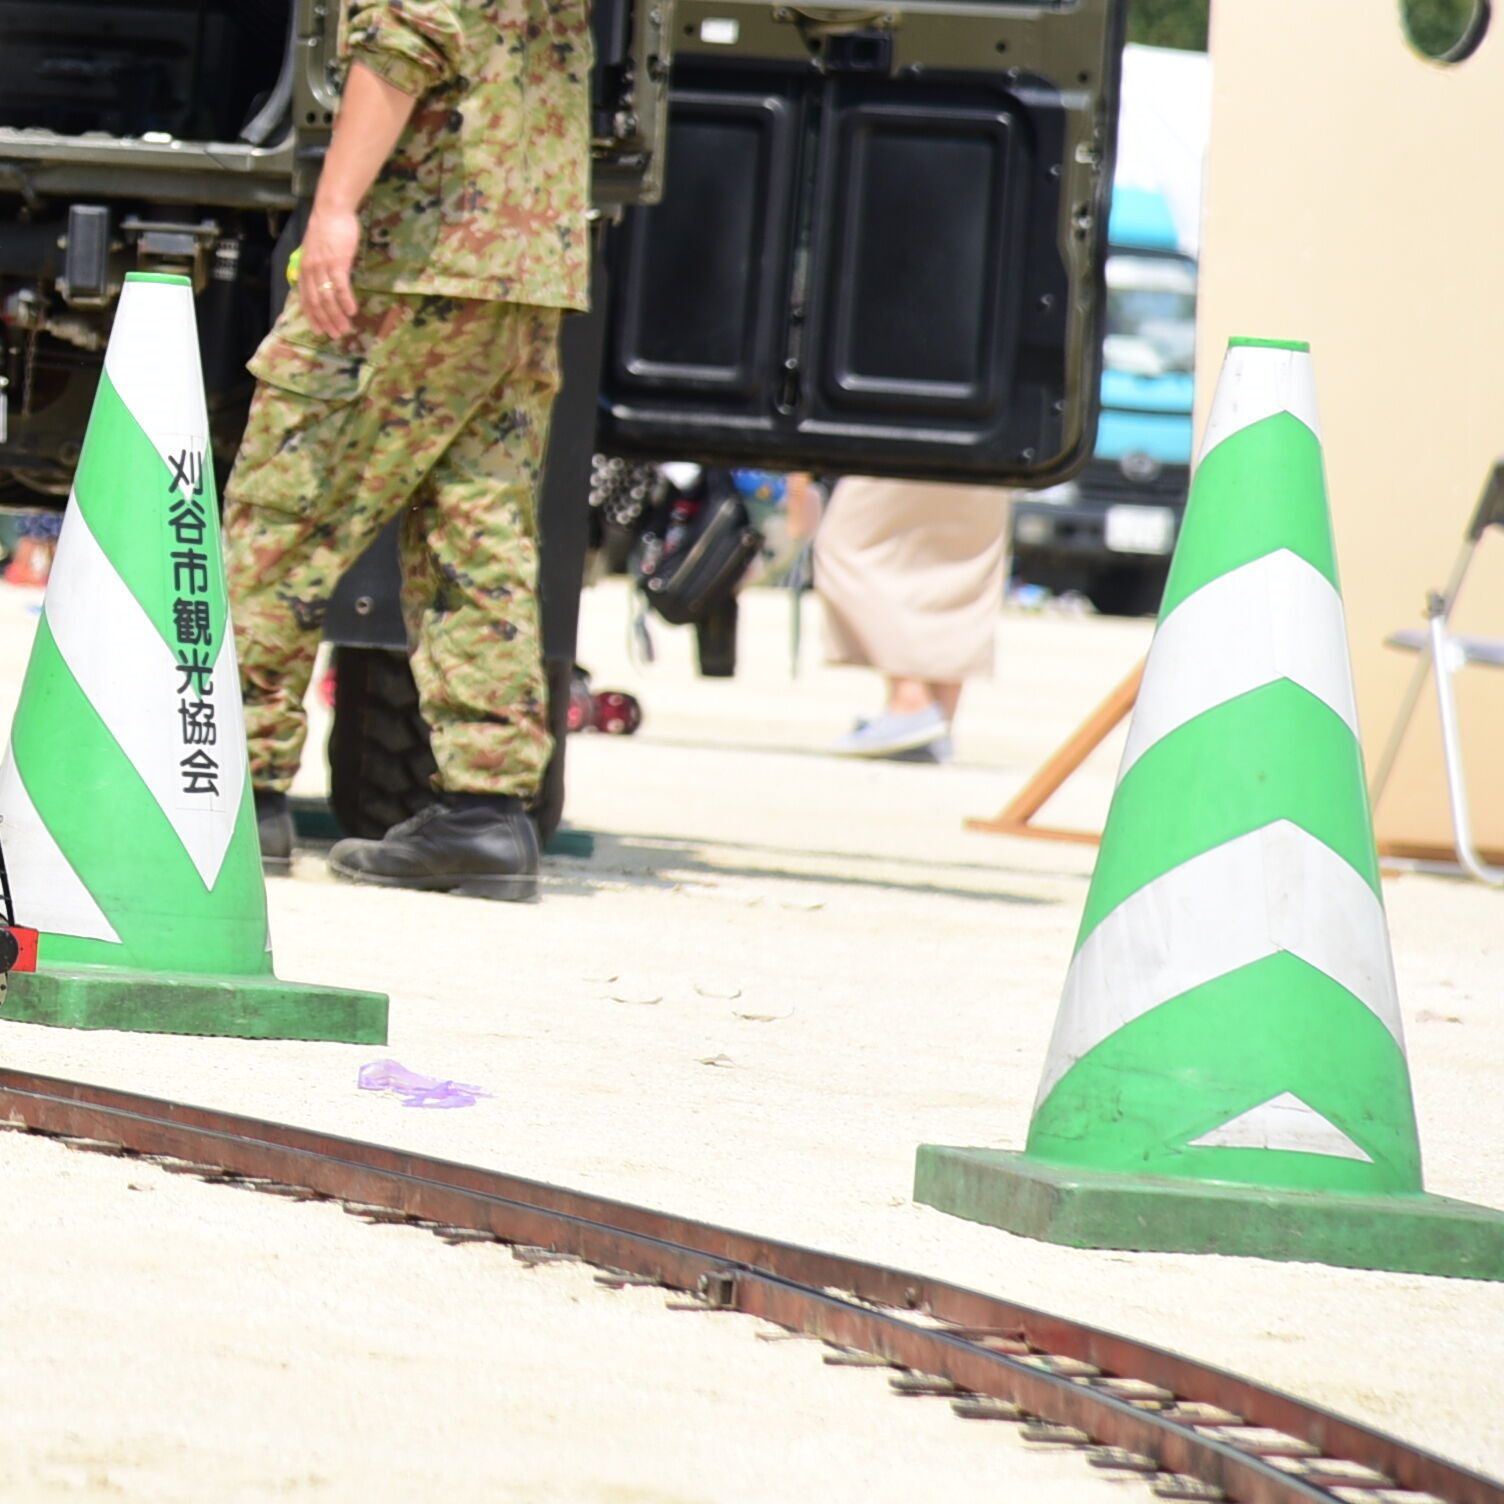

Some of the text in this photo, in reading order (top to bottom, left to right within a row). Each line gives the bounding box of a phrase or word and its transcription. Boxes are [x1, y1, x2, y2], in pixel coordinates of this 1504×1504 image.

[167, 448, 220, 798] 刈谷市観光協会
